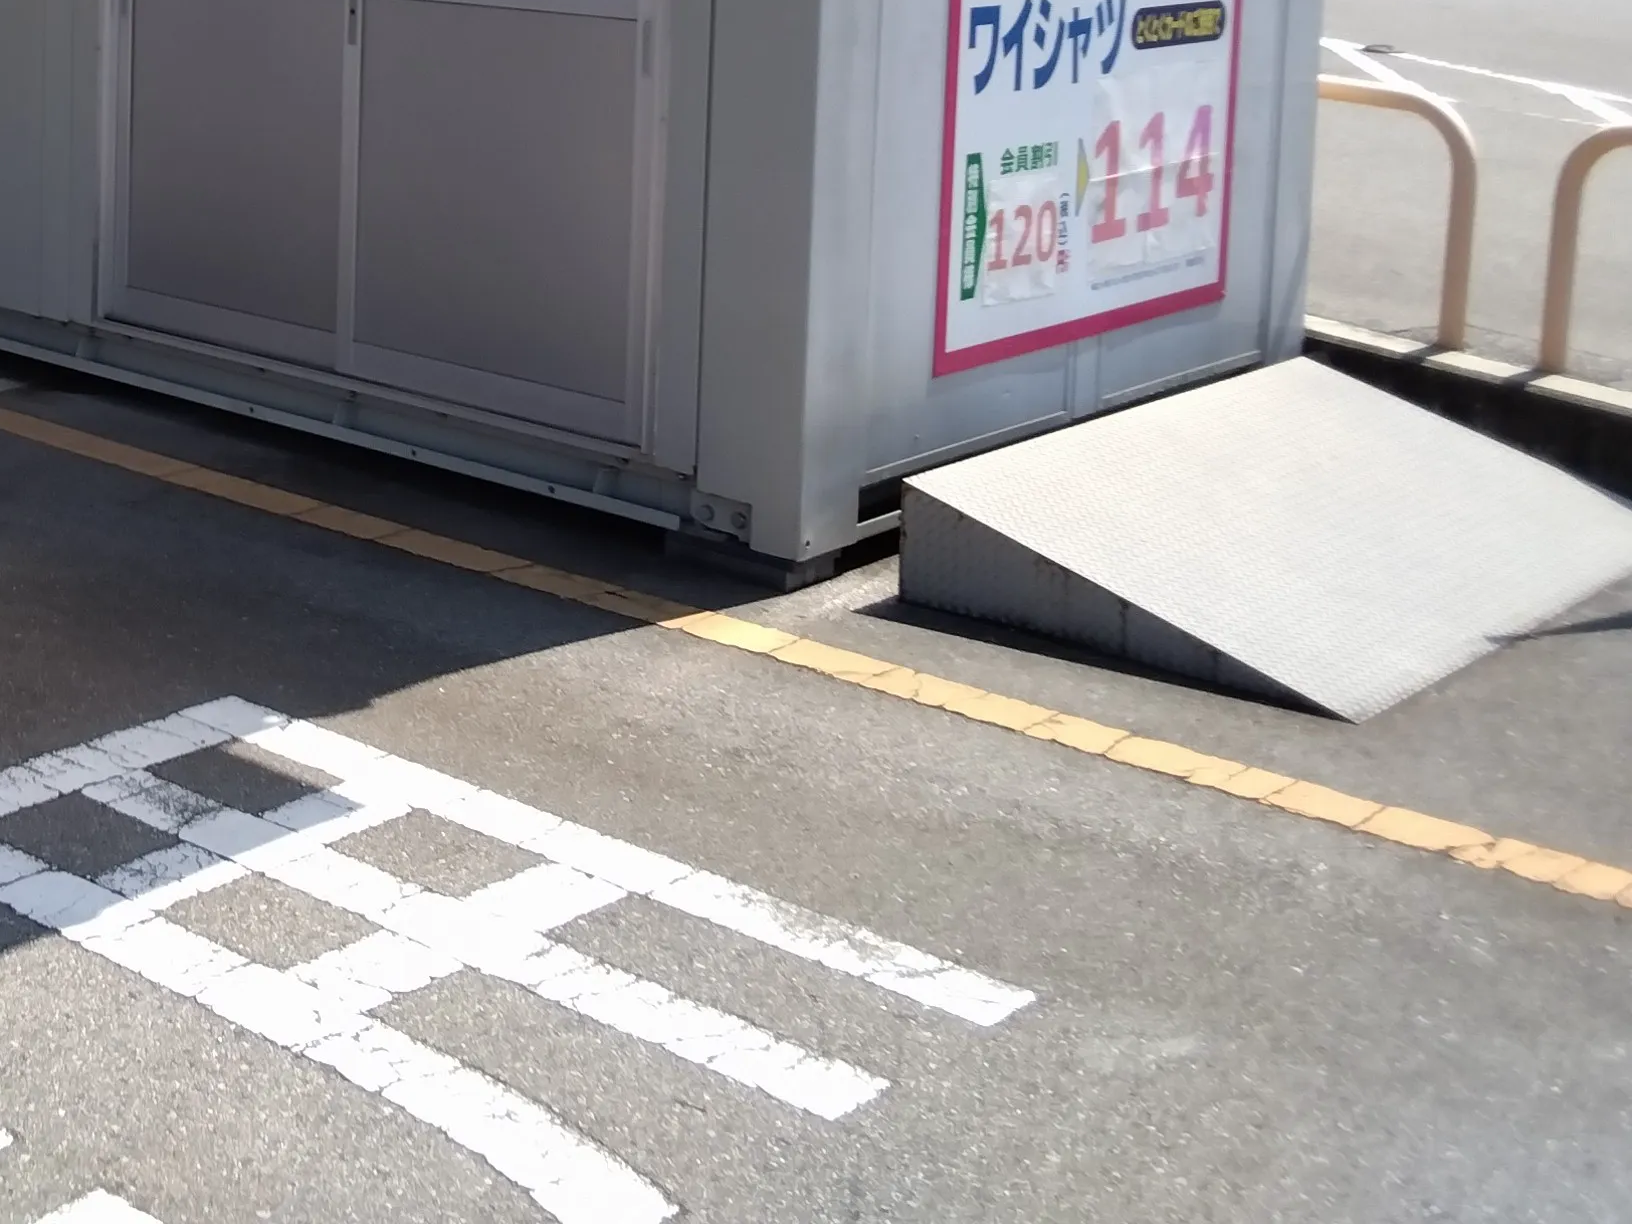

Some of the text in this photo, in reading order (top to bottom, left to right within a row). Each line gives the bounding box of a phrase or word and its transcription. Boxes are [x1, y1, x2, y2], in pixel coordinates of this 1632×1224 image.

[1000, 140, 1059, 176] 会員割引
[1091, 104, 1215, 245] 114
[987, 200, 1058, 272] 120
